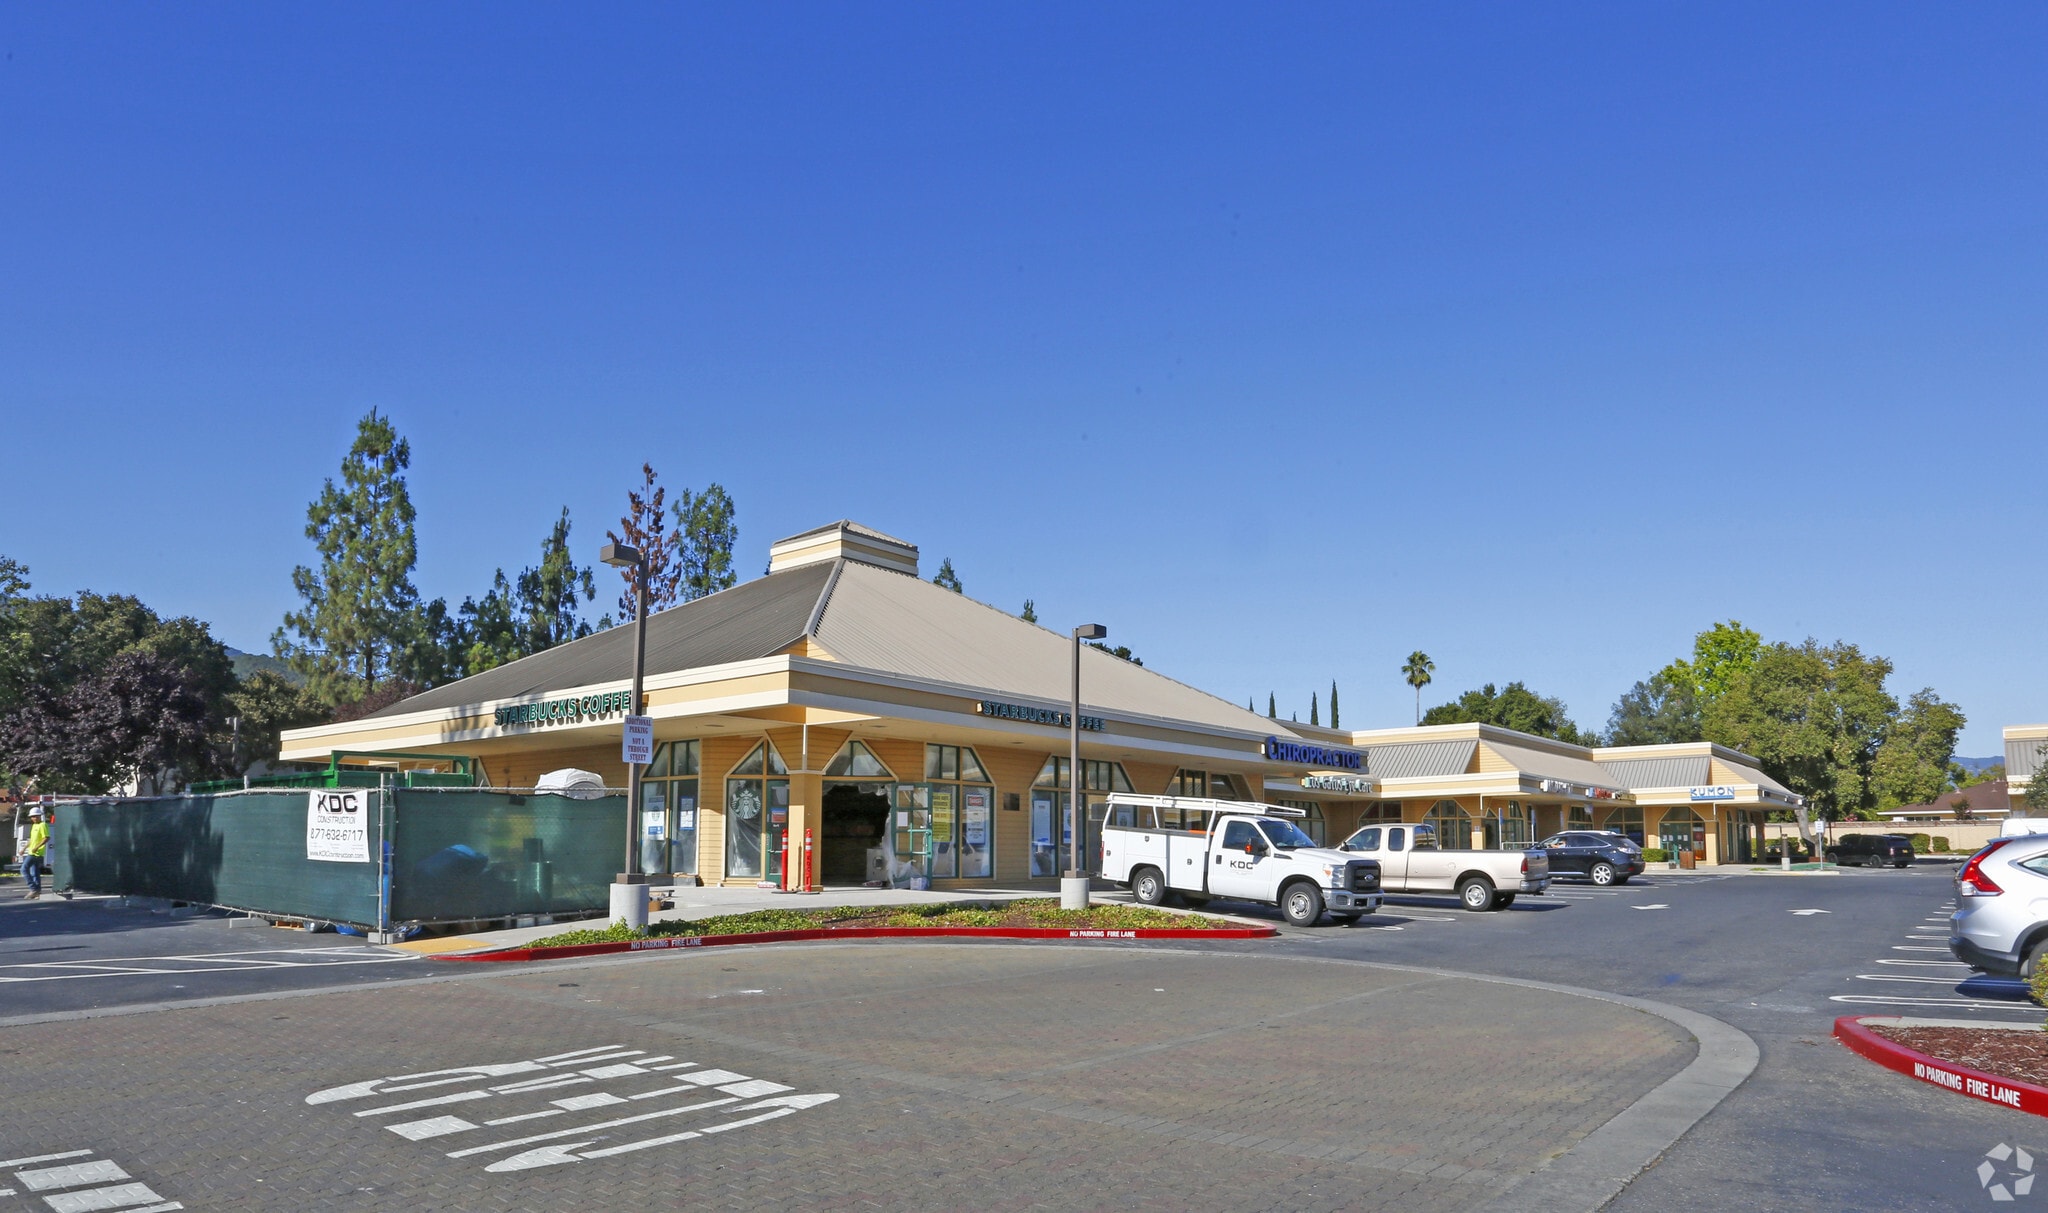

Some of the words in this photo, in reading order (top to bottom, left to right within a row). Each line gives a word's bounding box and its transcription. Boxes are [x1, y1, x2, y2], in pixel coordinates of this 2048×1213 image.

[494, 698, 577, 726] STARBUCKS
[580, 690, 633, 715] COFFE
[983, 701, 1061, 725] STARBUCKS
[1063, 713, 1106, 731] CFFEE
[626, 717, 652, 727] ADDITIONAL
[629, 726, 649, 735] PARKING
[632, 737, 641, 745] NOT
[628, 745, 649, 754] THROUGH
[1267, 736, 1361, 768] CHIROPRACTOR
[630, 753, 646, 761] STREET
[1690, 786, 1734, 797] KUMON
[317, 794, 358, 813] KDC
[317, 815, 356, 824] CONSTRUCTION
[311, 828, 363, 841] 877-632-6717
[1230, 860, 1254, 870] KDC
[631, 941, 640, 950] NO
[641, 940, 668, 949] PARKING
[671, 938, 685, 947] FIRE
[686, 938, 702, 946] LANE
[1914, 1062, 1925, 1078] NO
[1926, 1065, 1962, 1090] PARKING
[1966, 1078, 1989, 1098] FIRE
[1991, 1085, 2021, 1107] LANE
